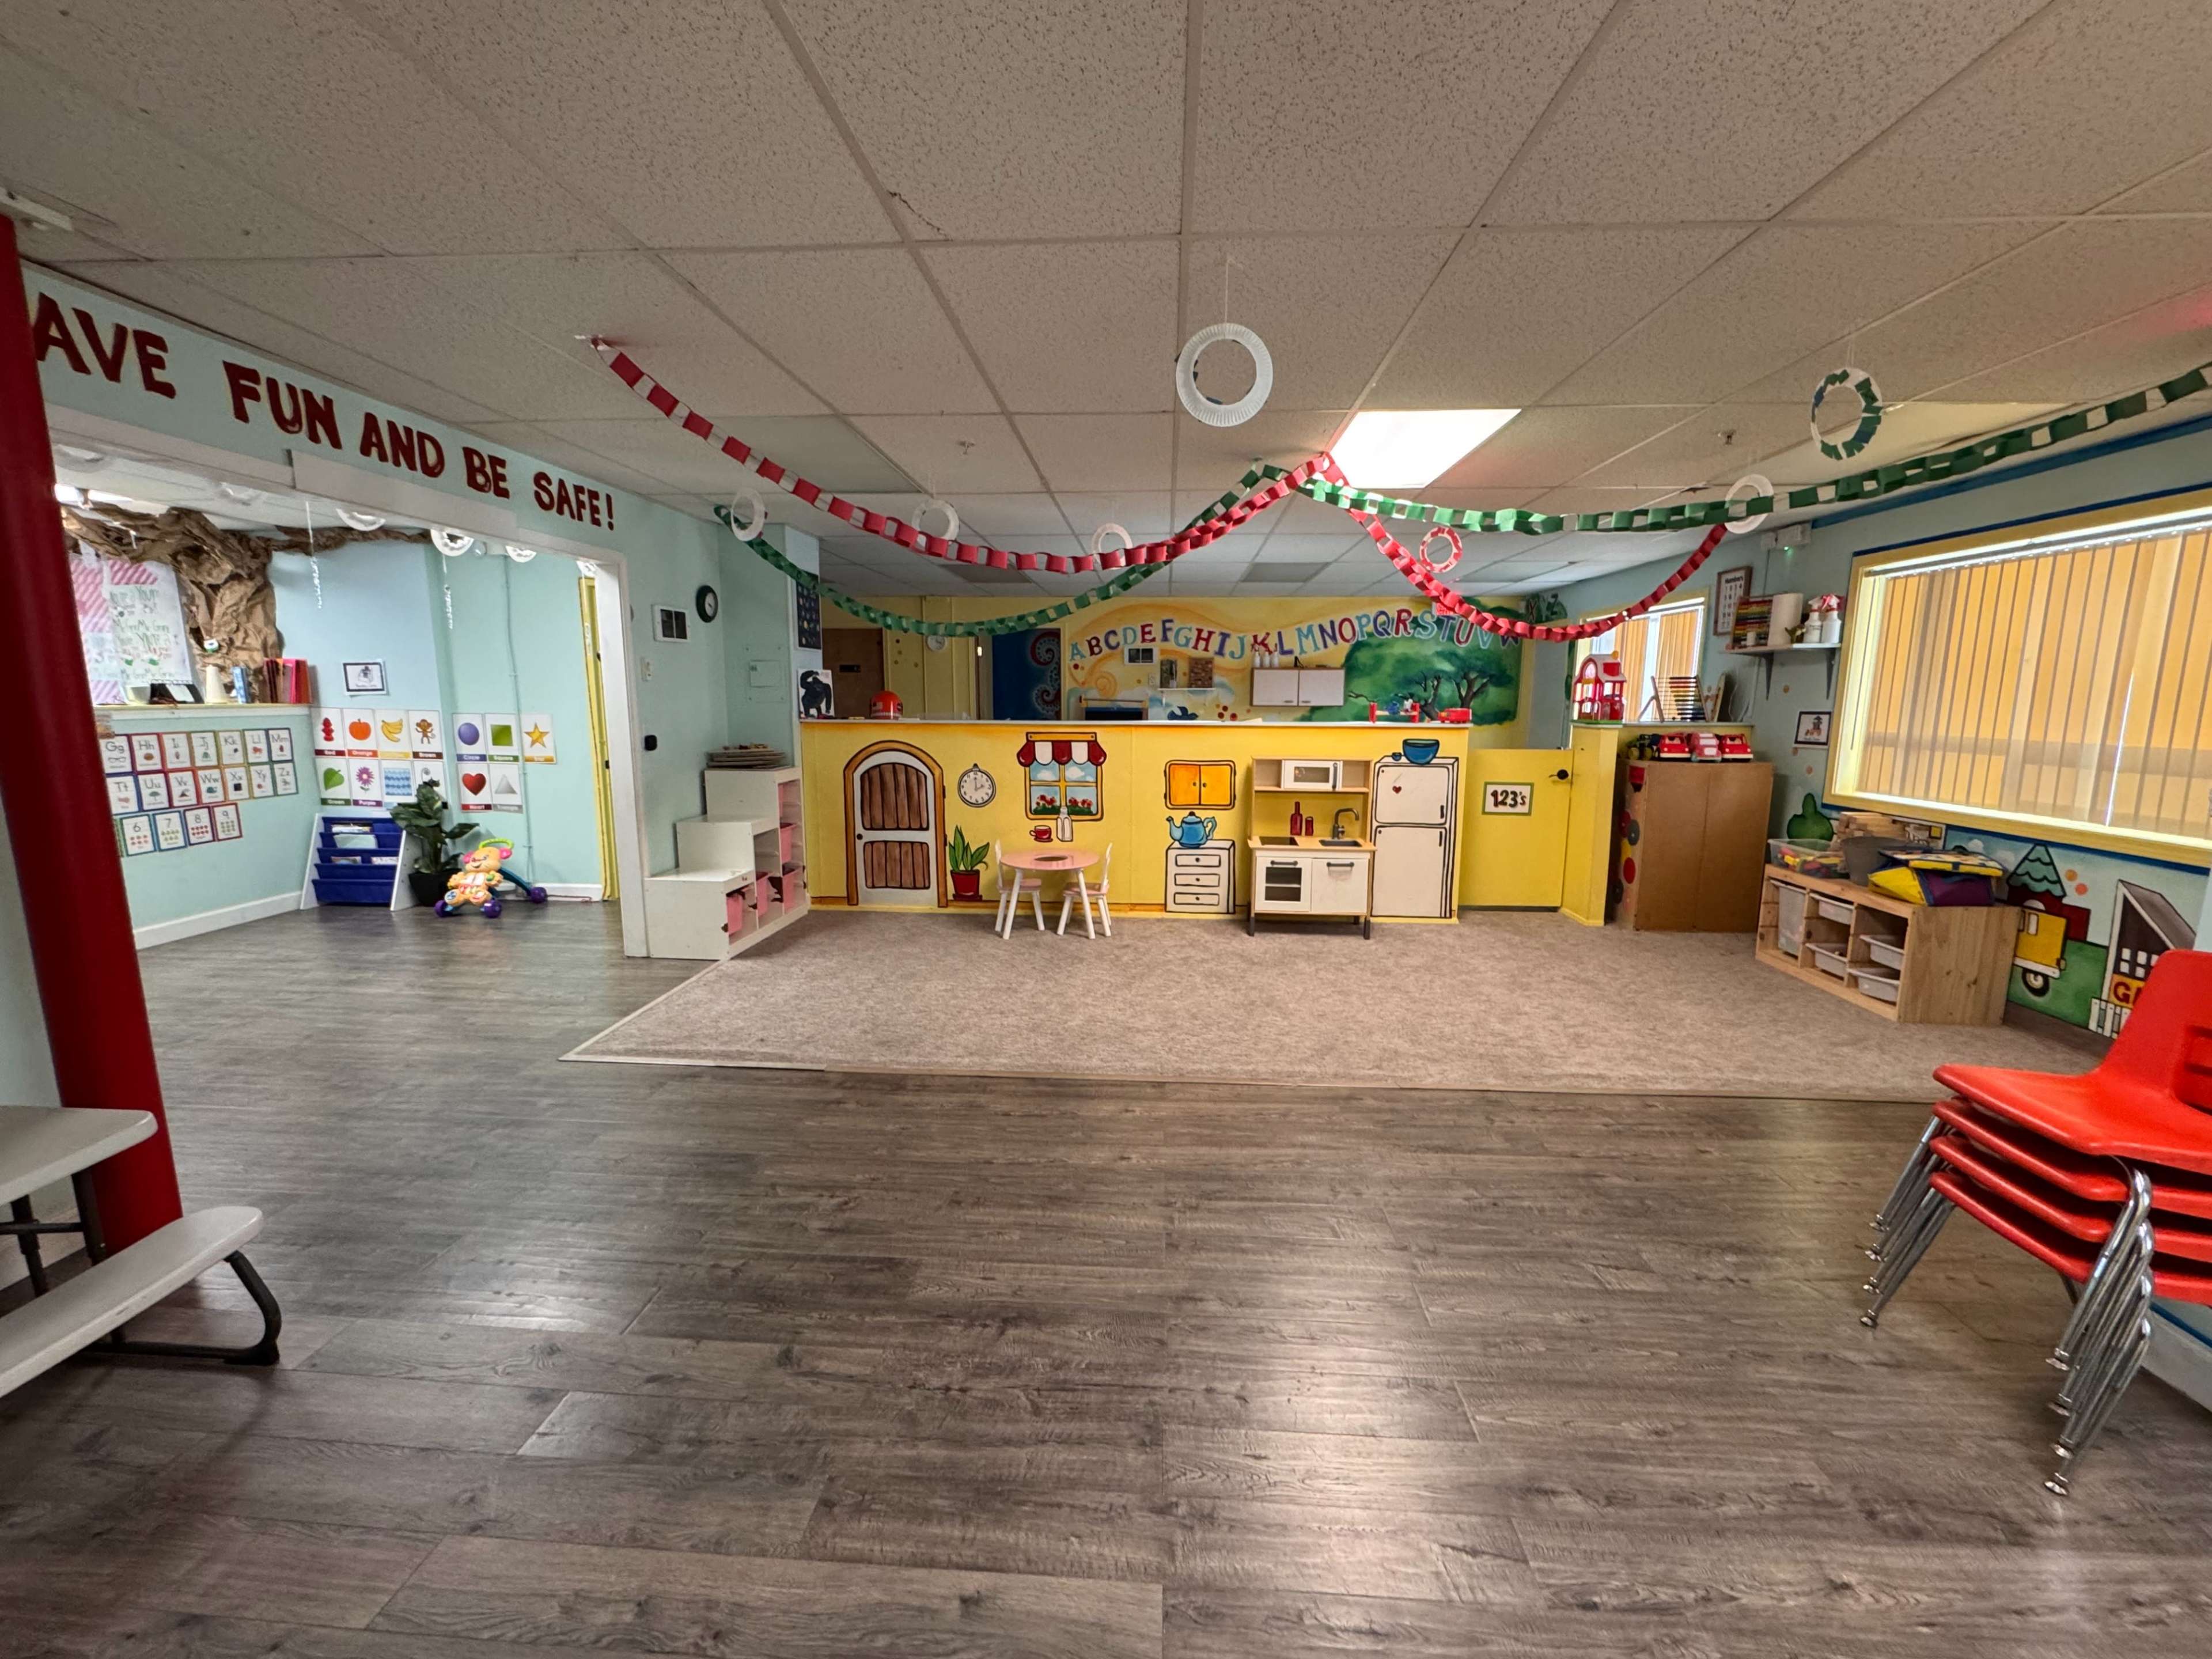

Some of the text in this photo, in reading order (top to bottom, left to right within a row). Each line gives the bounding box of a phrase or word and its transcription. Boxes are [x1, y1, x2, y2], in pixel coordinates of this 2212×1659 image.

[33, 291, 614, 531] AVE FUN AND BE SAFE!
[105, 741, 124, 754] Gg
[138, 741, 155, 750] Hh
[255, 770, 267, 783] Yy
[278, 767, 290, 777] Zz
[144, 779, 161, 789] Uu
[200, 774, 220, 784] Ww
[113, 781, 129, 793] Tt
[1490, 789, 1527, 808] 123's
[195, 814, 202, 824] 8
[222, 810, 230, 820] 9
[133, 822, 141, 833] 6
[164, 818, 172, 828] 7
